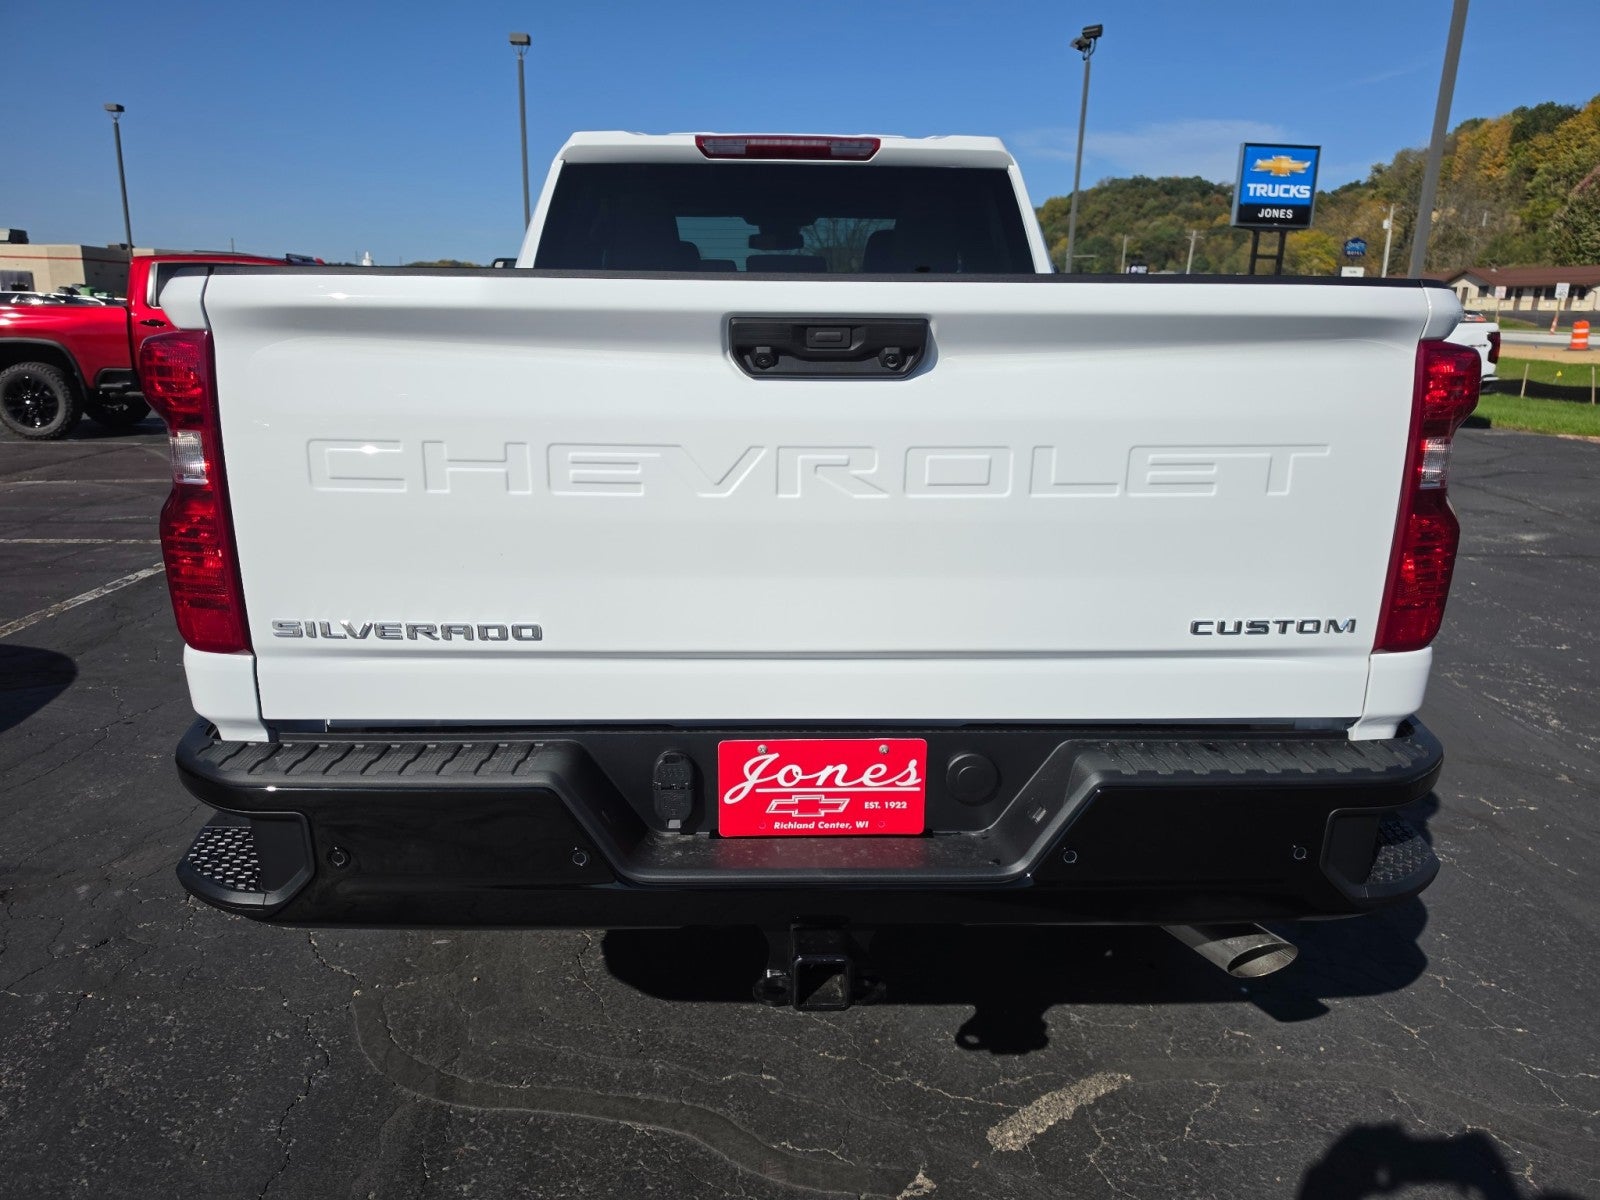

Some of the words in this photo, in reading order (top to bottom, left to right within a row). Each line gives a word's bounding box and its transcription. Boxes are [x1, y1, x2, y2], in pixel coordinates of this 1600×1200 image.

[1246, 183, 1311, 199] TRUCKS
[1257, 208, 1293, 219] JONES
[307, 439, 1331, 499] CHEVROLET
[271, 619, 543, 641] SILVERADO
[1190, 618, 1357, 636] CUSTOM
[723, 752, 922, 805] Jones
[864, 801, 881, 810] EST.
[884, 801, 908, 810] 1922
[773, 820, 816, 830] Richland
[818, 820, 853, 830] Center,
[855, 820, 869, 829] WI
